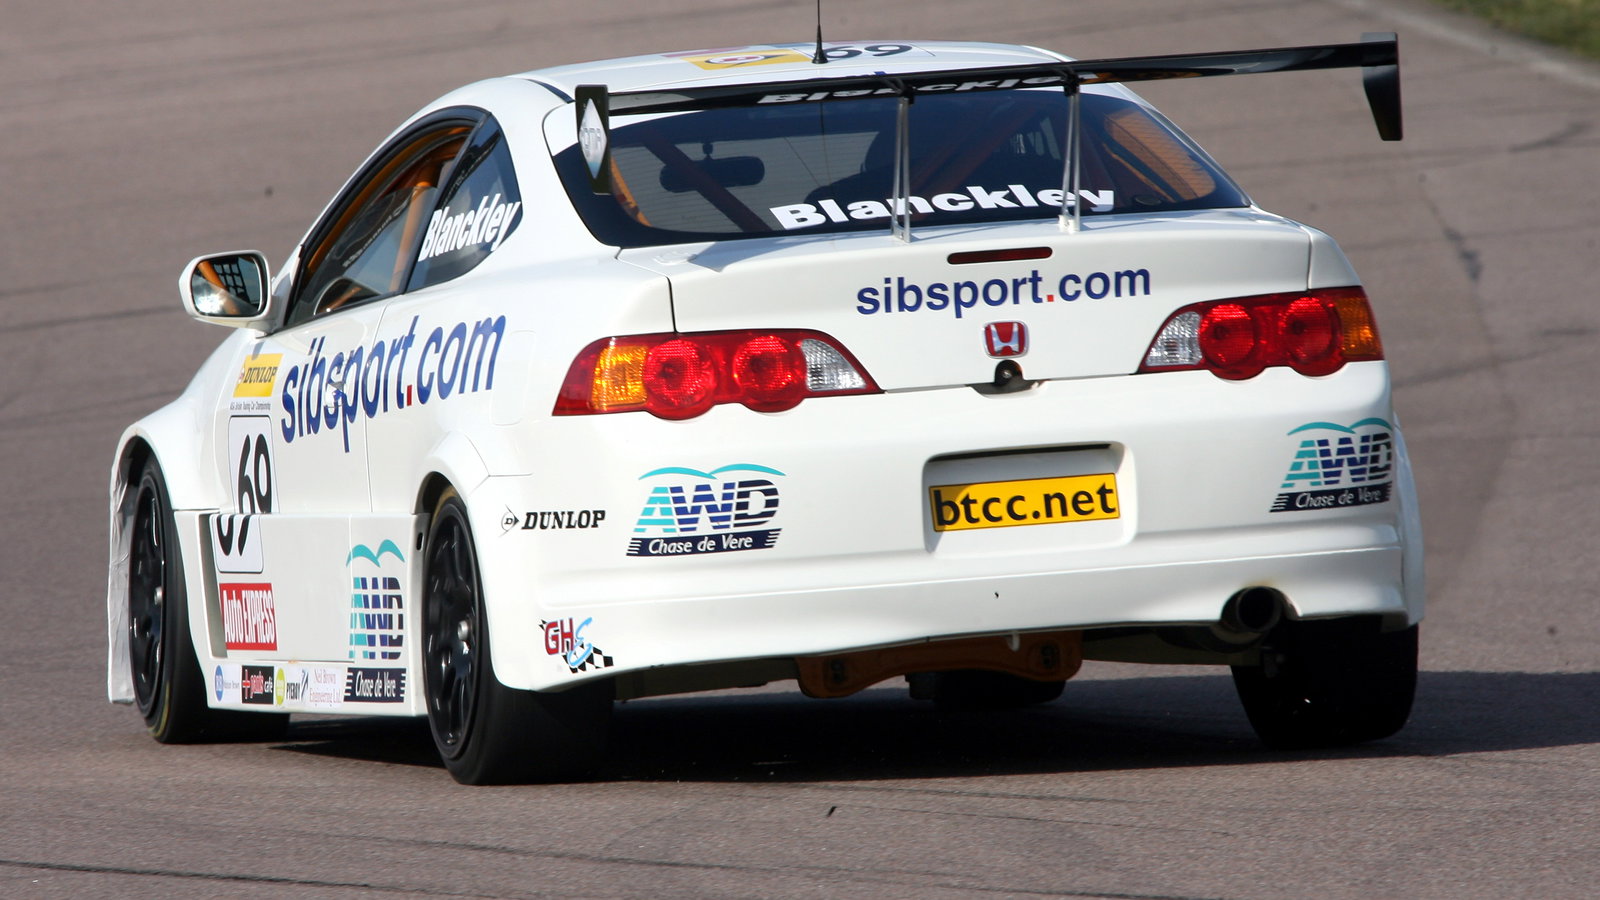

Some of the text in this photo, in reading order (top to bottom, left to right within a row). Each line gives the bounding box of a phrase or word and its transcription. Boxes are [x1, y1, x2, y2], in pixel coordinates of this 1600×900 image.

[821, 44, 912, 59] 69
[418, 193, 521, 262] Blanckley
[770, 184, 1114, 230] Blanckley
[856, 267, 1151, 319] sibsport.com
[243, 366, 278, 384] DUNLOP
[281, 314, 506, 453] sibsport.com
[1281, 432, 1392, 488] AWD
[521, 509, 606, 530] DUNLOP
[633, 479, 780, 533] AWD
[933, 482, 1117, 527] btcc.net
[1295, 487, 1381, 508] Chase de Vere
[648, 533, 754, 554] Chase de Vere
[223, 590, 276, 644] Auto EXPRESS
[349, 577, 404, 660] AWD
[355, 671, 397, 698] Chase de Vere
